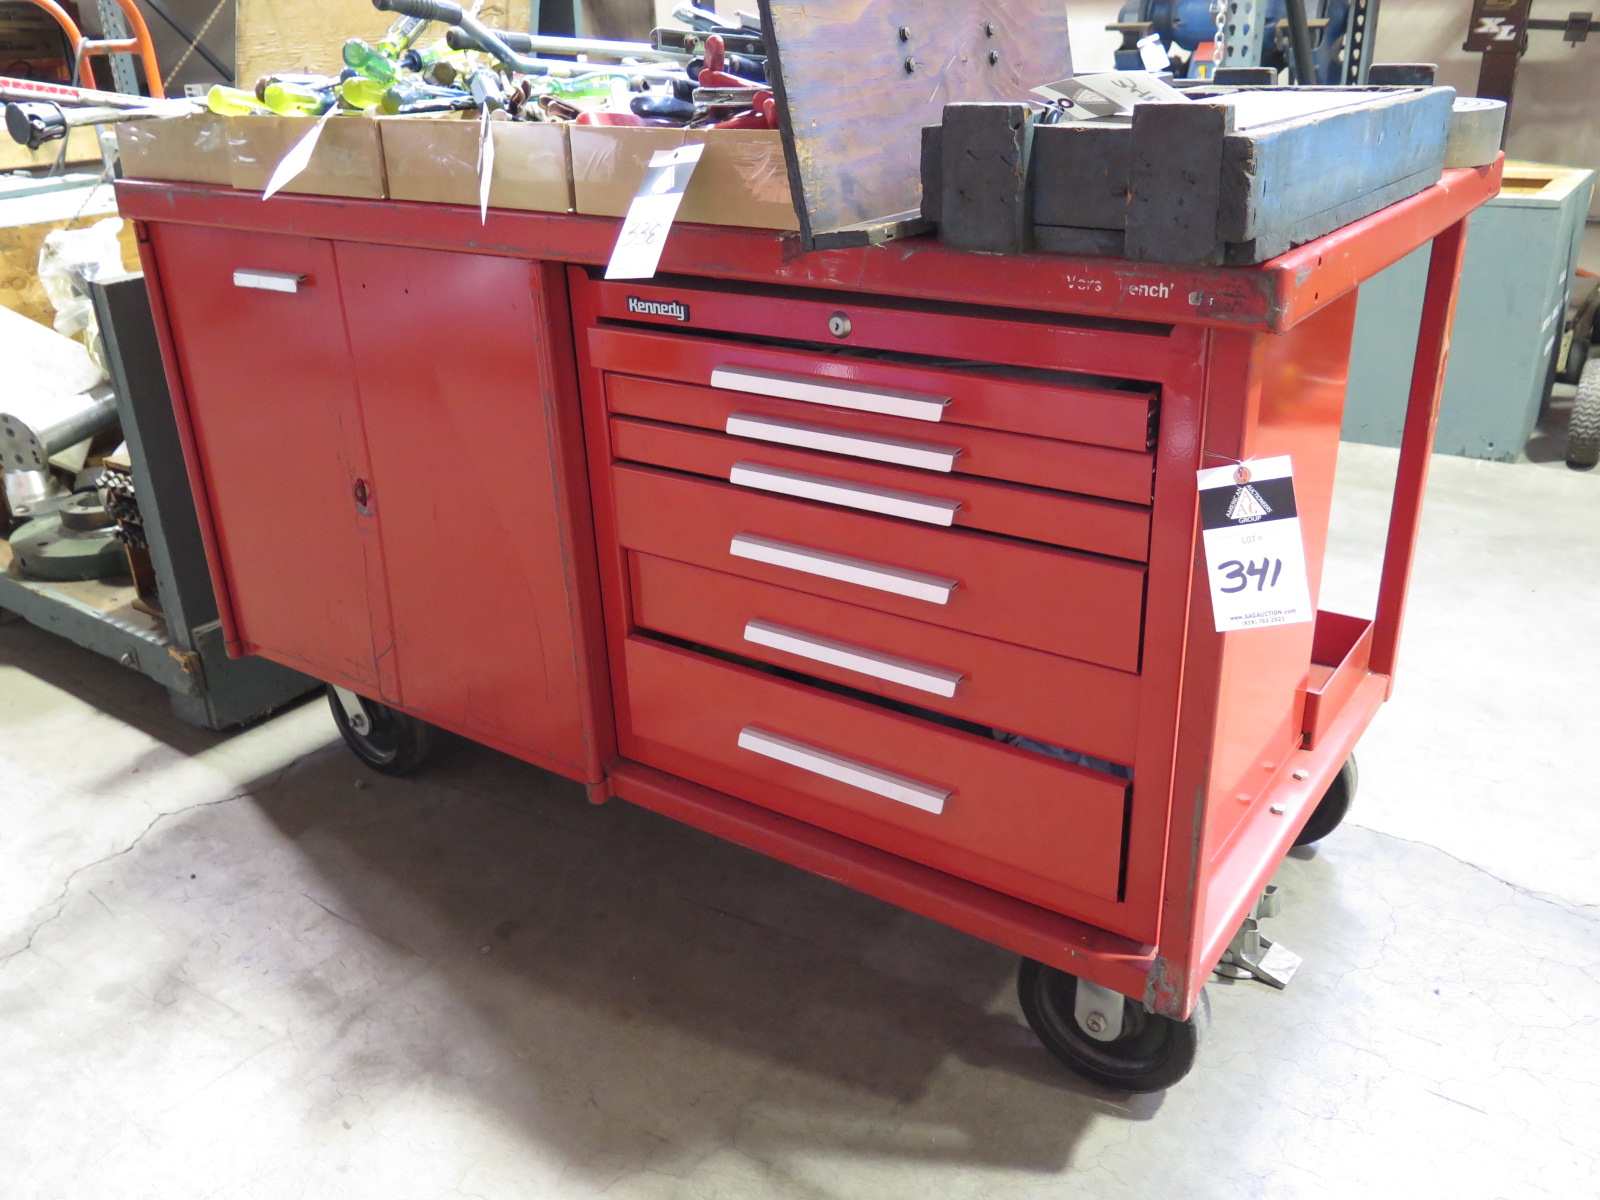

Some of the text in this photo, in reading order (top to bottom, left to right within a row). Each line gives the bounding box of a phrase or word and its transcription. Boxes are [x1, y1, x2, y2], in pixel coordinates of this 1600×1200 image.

[628, 298, 685, 321] Kennedy
[1225, 486, 1243, 518] AMERICAN
[1245, 484, 1273, 514] AUCTIONEERS
[1238, 515, 1262, 524] GROUP
[1241, 535, 1257, 544] LOT
[1217, 557, 1282, 594] 341
[1229, 608, 1297, 621] www.AAGAUCTION.com
